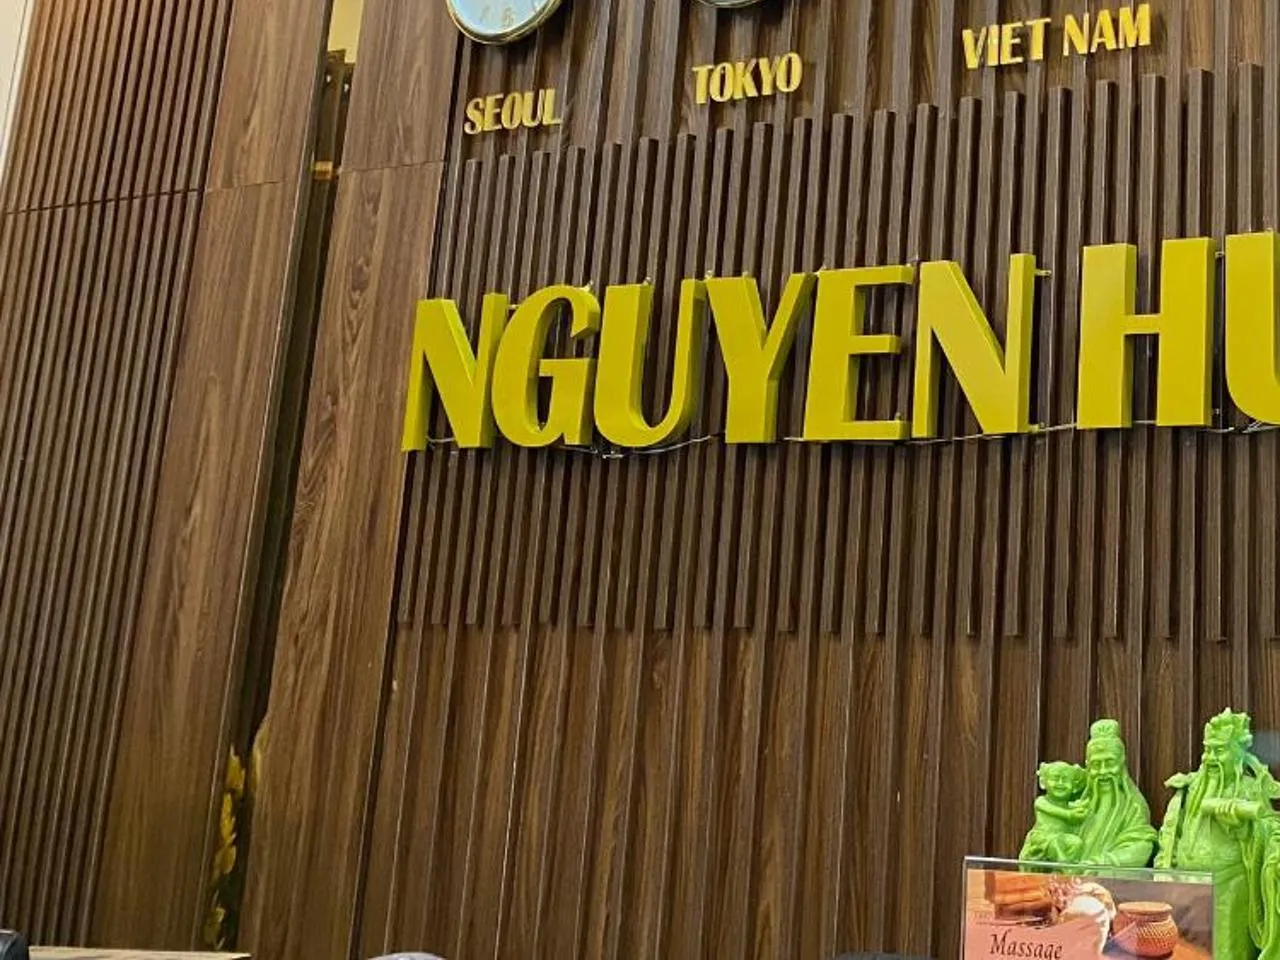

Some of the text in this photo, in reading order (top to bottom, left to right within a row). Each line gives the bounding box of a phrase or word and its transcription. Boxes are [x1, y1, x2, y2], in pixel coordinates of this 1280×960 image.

[961, 3, 1151, 69] VIET NAM
[692, 52, 802, 104] TOKYO
[464, 88, 562, 134] SEOUL
[402, 252, 1036, 452] NGUYEN
